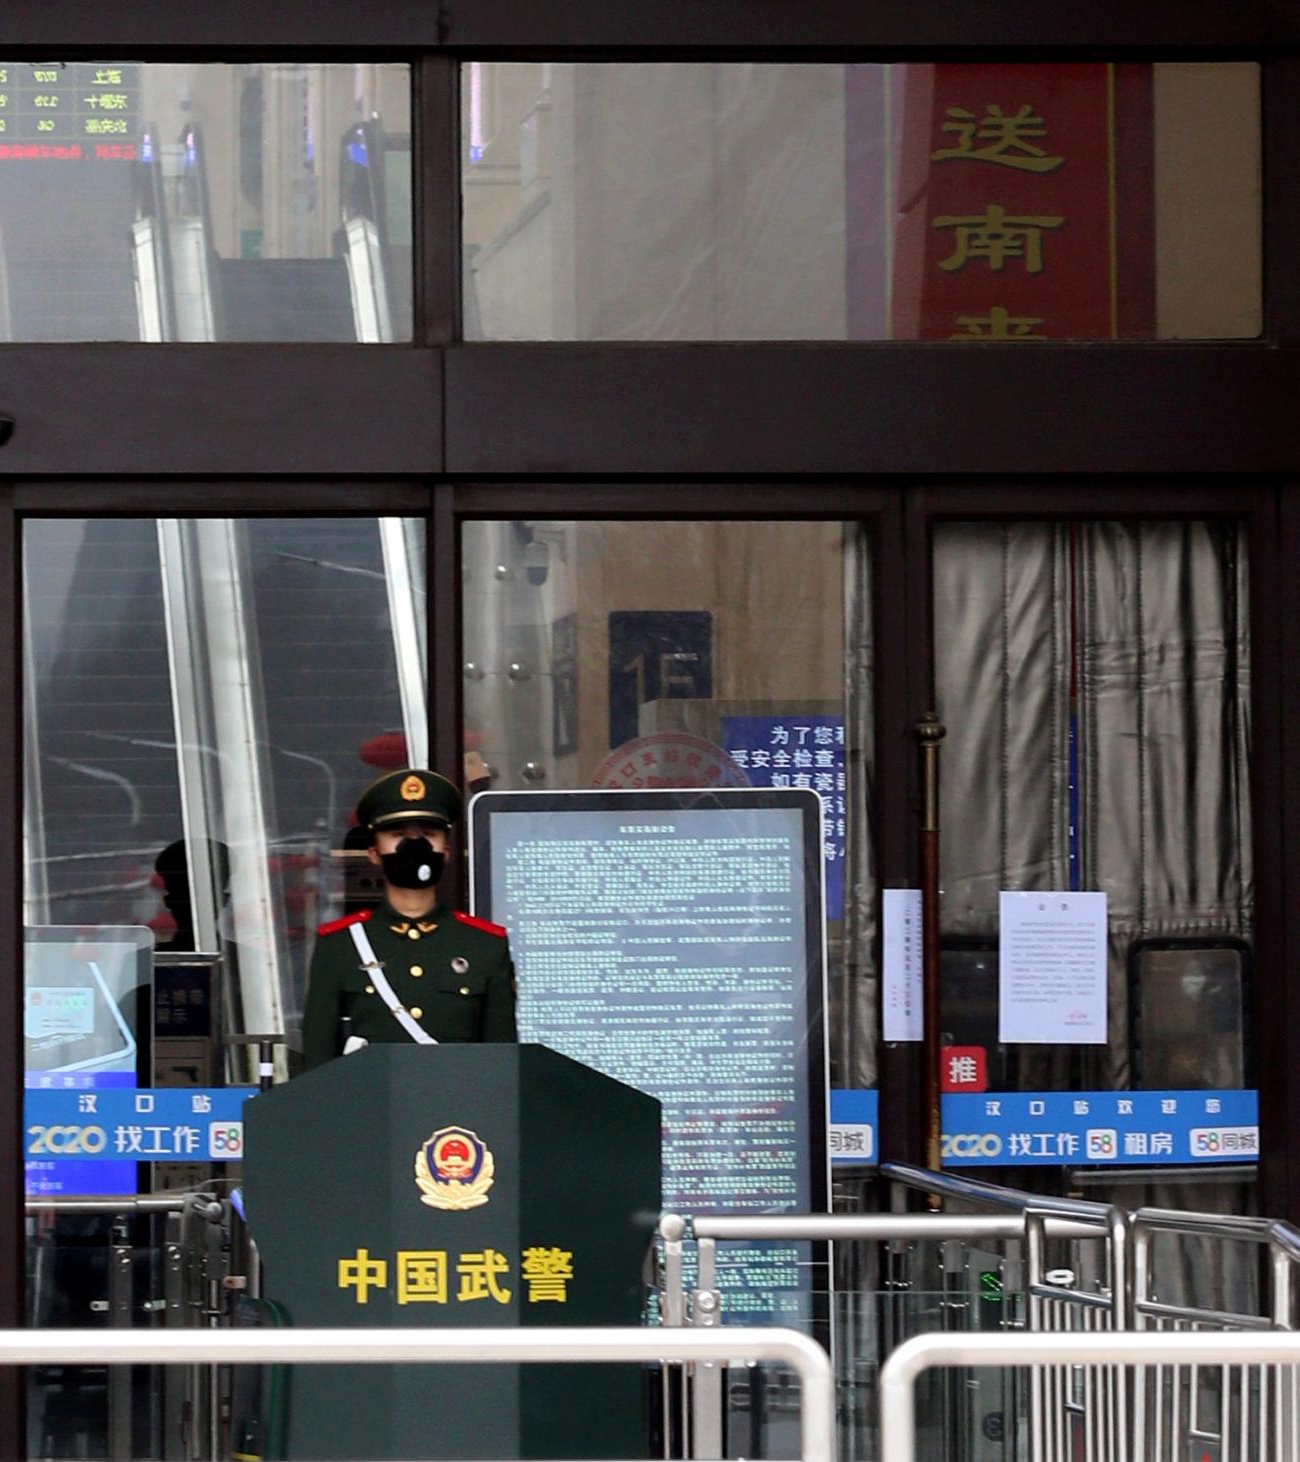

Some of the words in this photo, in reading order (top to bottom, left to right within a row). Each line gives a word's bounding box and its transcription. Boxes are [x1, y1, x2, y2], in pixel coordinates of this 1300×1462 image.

[949, 1055, 977, 1084] 推
[79, 1095, 212, 1114] 汉口站
[985, 1099, 1221, 1115] 汉口站欢迎您
[27, 1126, 107, 1153] 2020
[114, 1126, 200, 1153] 找工作
[214, 1127, 241, 1153] 58
[941, 1134, 1001, 1157] 2020
[1008, 1133, 1079, 1156] 找工作
[1090, 1135, 1113, 1154] 58
[1125, 1132, 1173, 1155] 租房
[1195, 1131, 1258, 1153] 58同城
[337, 1246, 575, 1306] 中国武警
